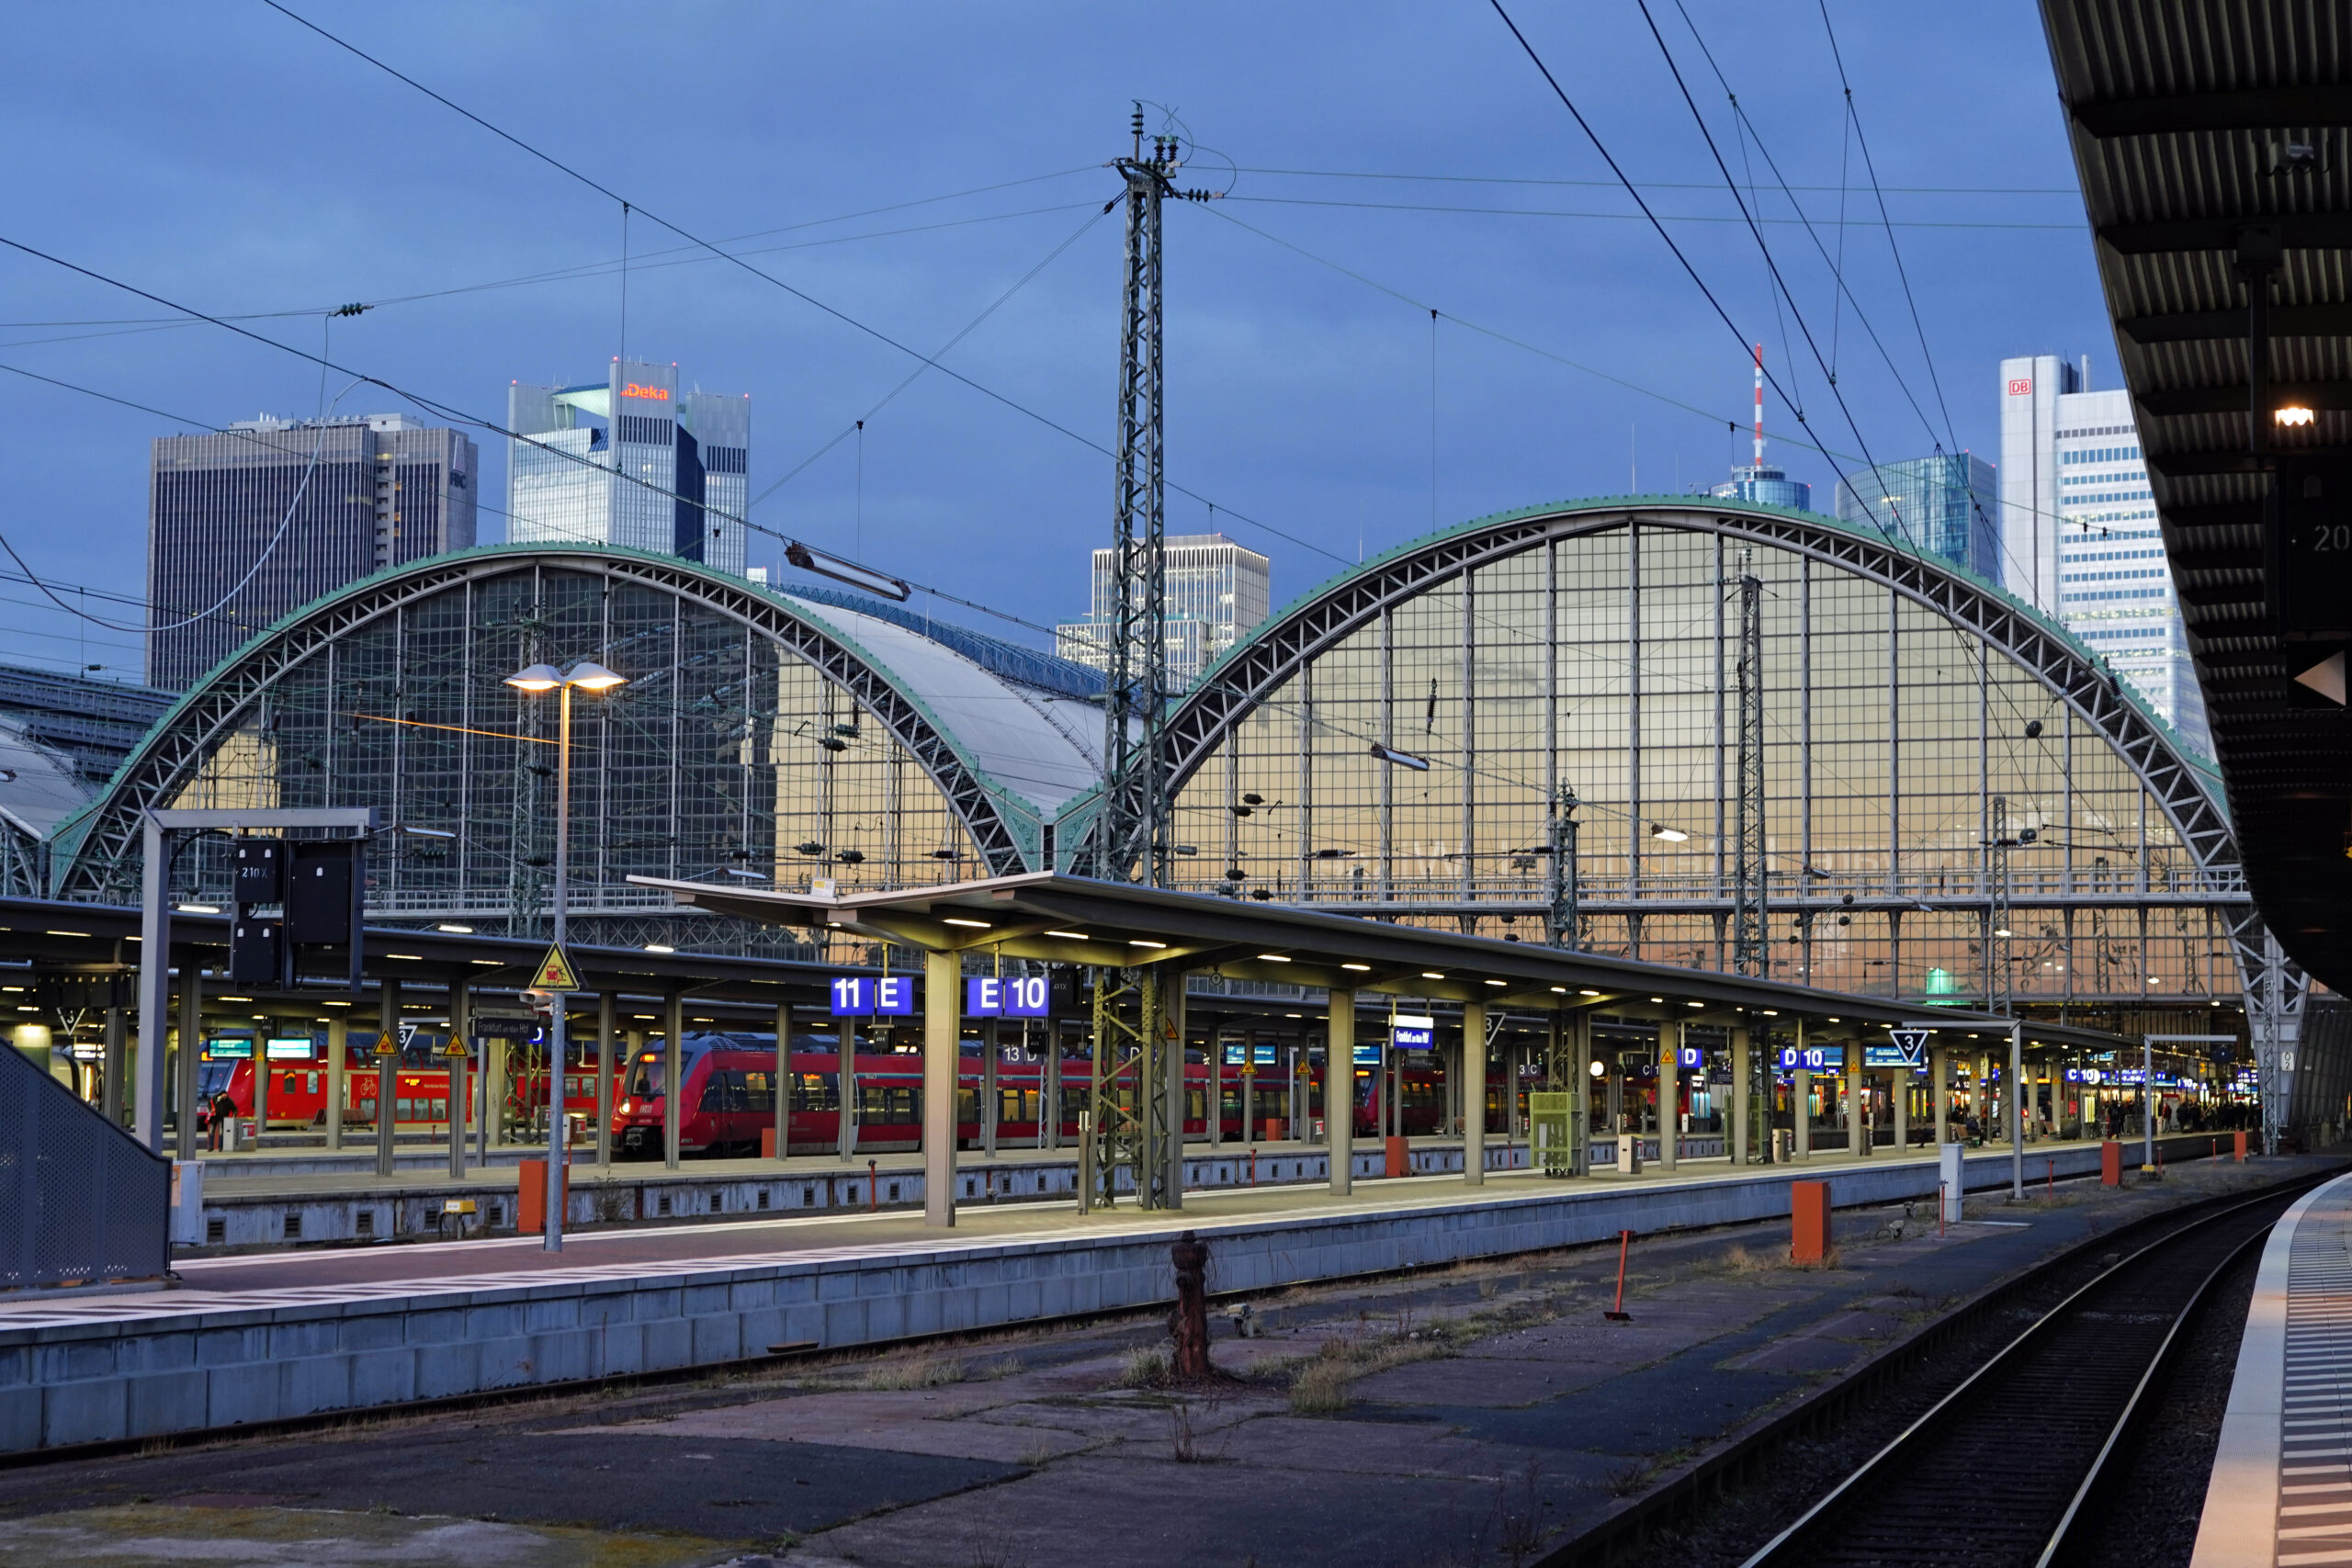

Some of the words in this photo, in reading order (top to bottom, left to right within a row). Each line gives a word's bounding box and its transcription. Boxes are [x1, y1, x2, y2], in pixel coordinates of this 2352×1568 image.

[626, 383, 669, 400] Deka
[2010, 380, 2030, 394] DB
[242, 866, 268, 878] 210X
[834, 977, 860, 1009] 11
[880, 977, 899, 1008] E
[980, 978, 1000, 1009] E
[1012, 976, 1046, 1009] 10
[478, 1021, 503, 1033] Frankfurt
[399, 1030, 407, 1044] 3
[1904, 1034, 1915, 1052] 3
[1004, 1047, 1020, 1062] 13
[1684, 1048, 1697, 1065] D
[1784, 1049, 1797, 1066] D
[1804, 1050, 1823, 1066] 10
[1530, 1064, 1537, 1075] C
[1643, 1065, 1650, 1076] C
[2068, 1068, 2077, 1080] C
[2081, 1068, 2094, 1081] 10
[1954, 1080, 1961, 1089] A
[1962, 1080, 1971, 1089] 12
[2201, 1082, 2208, 1090] A
[2228, 1082, 2234, 1091] A
[2235, 1082, 2245, 1091] 10
